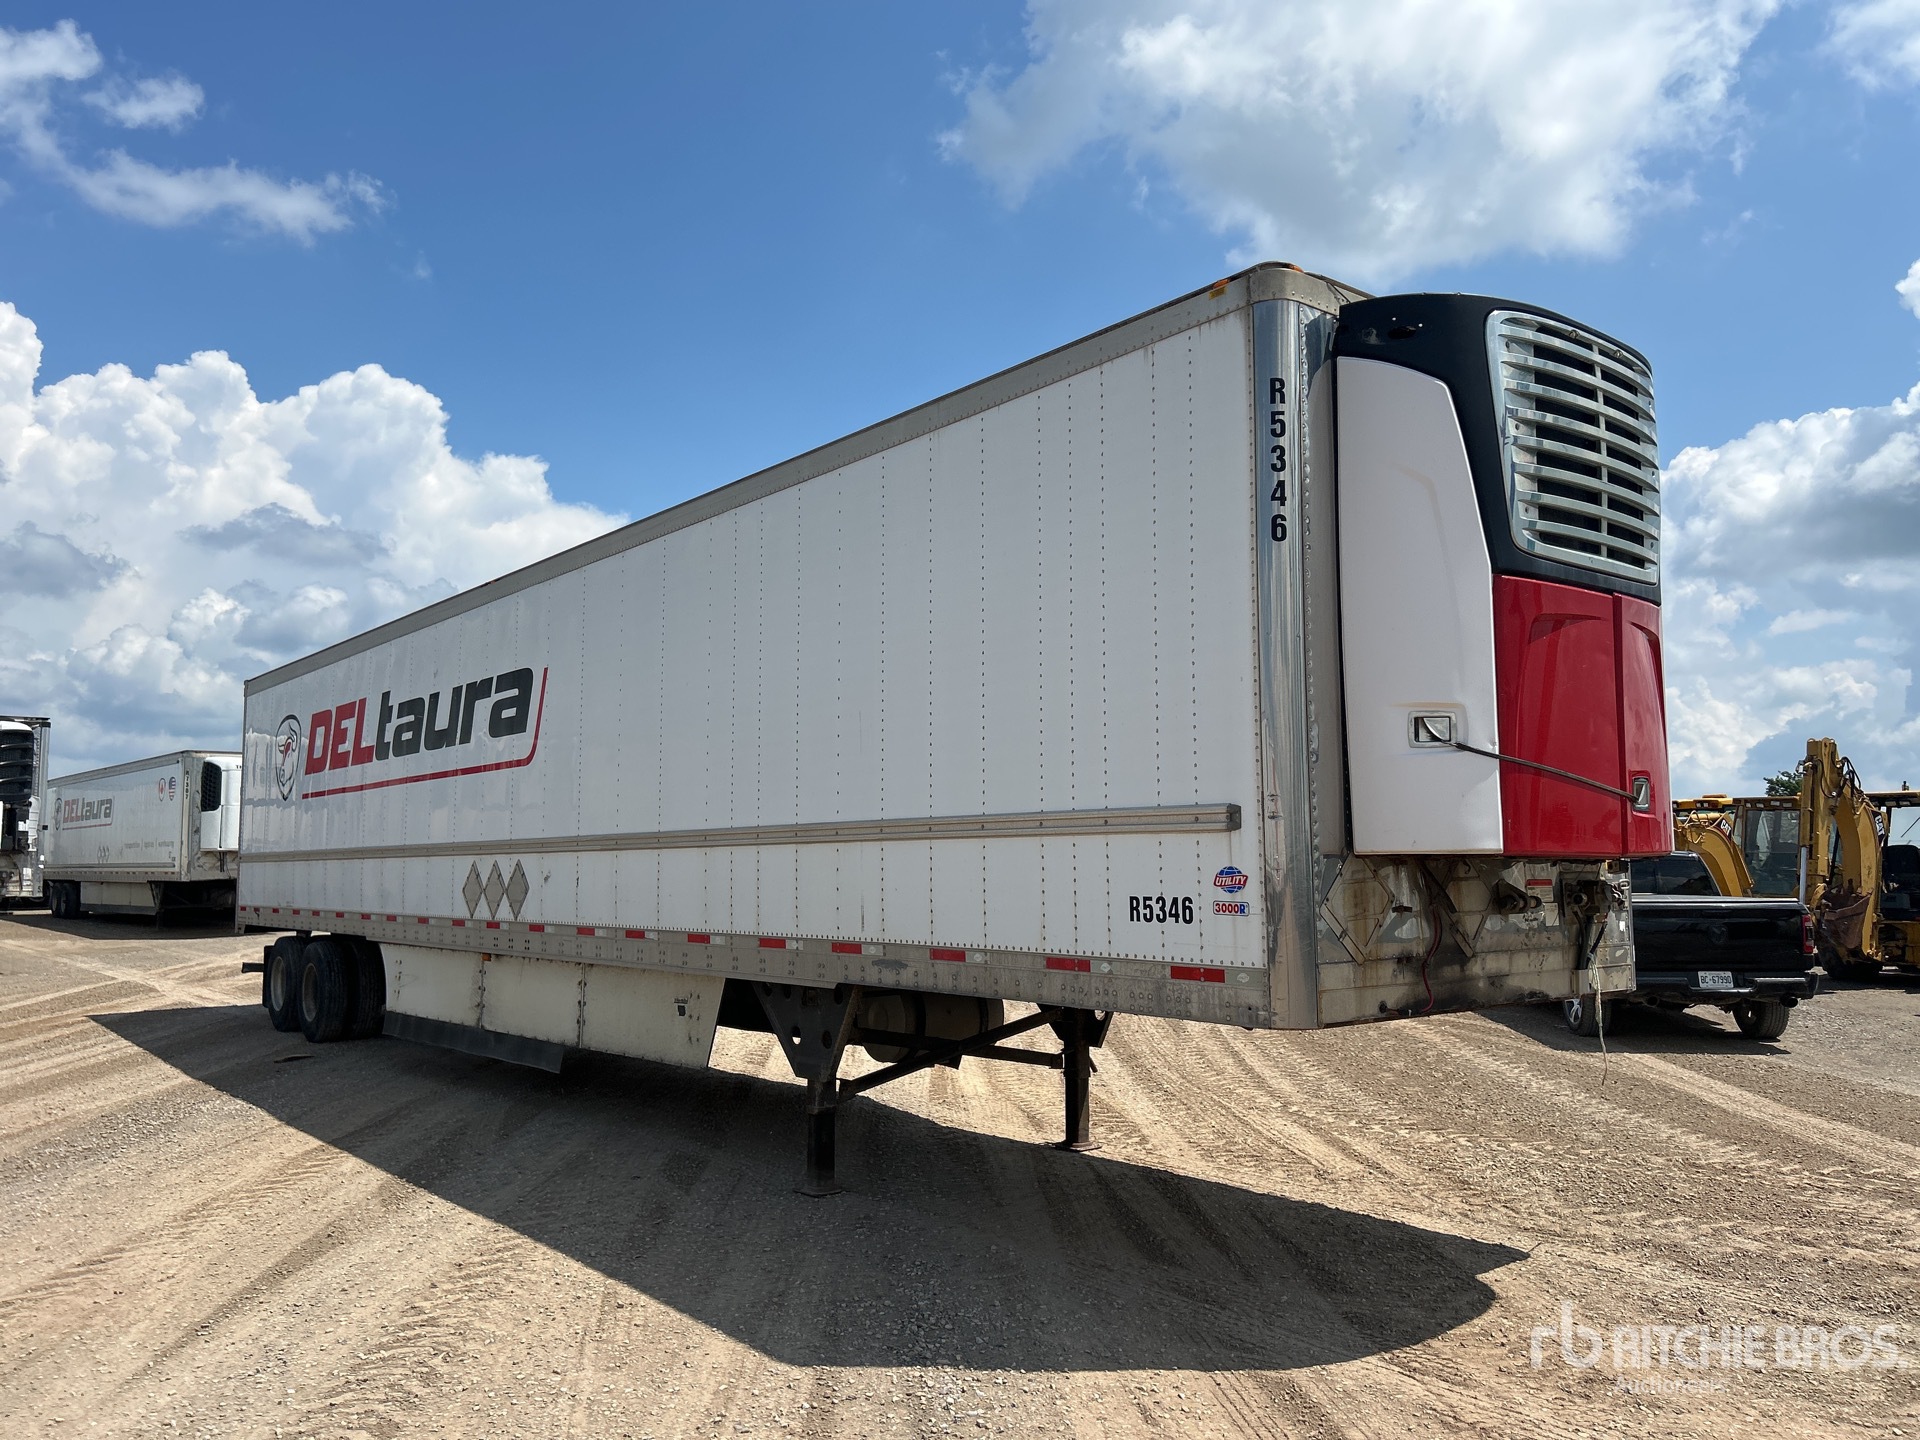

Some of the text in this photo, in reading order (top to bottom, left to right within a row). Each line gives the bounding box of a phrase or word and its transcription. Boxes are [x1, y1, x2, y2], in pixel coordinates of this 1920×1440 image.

[1269, 377, 1288, 542] R5346
[304, 667, 534, 776] DELtaura
[63, 797, 112, 823] DELtaura
[1874, 814, 1886, 836] CAT
[1215, 875, 1247, 886] UTILITY
[1129, 896, 1194, 925] R5346
[1214, 902, 1246, 914] 3000R
